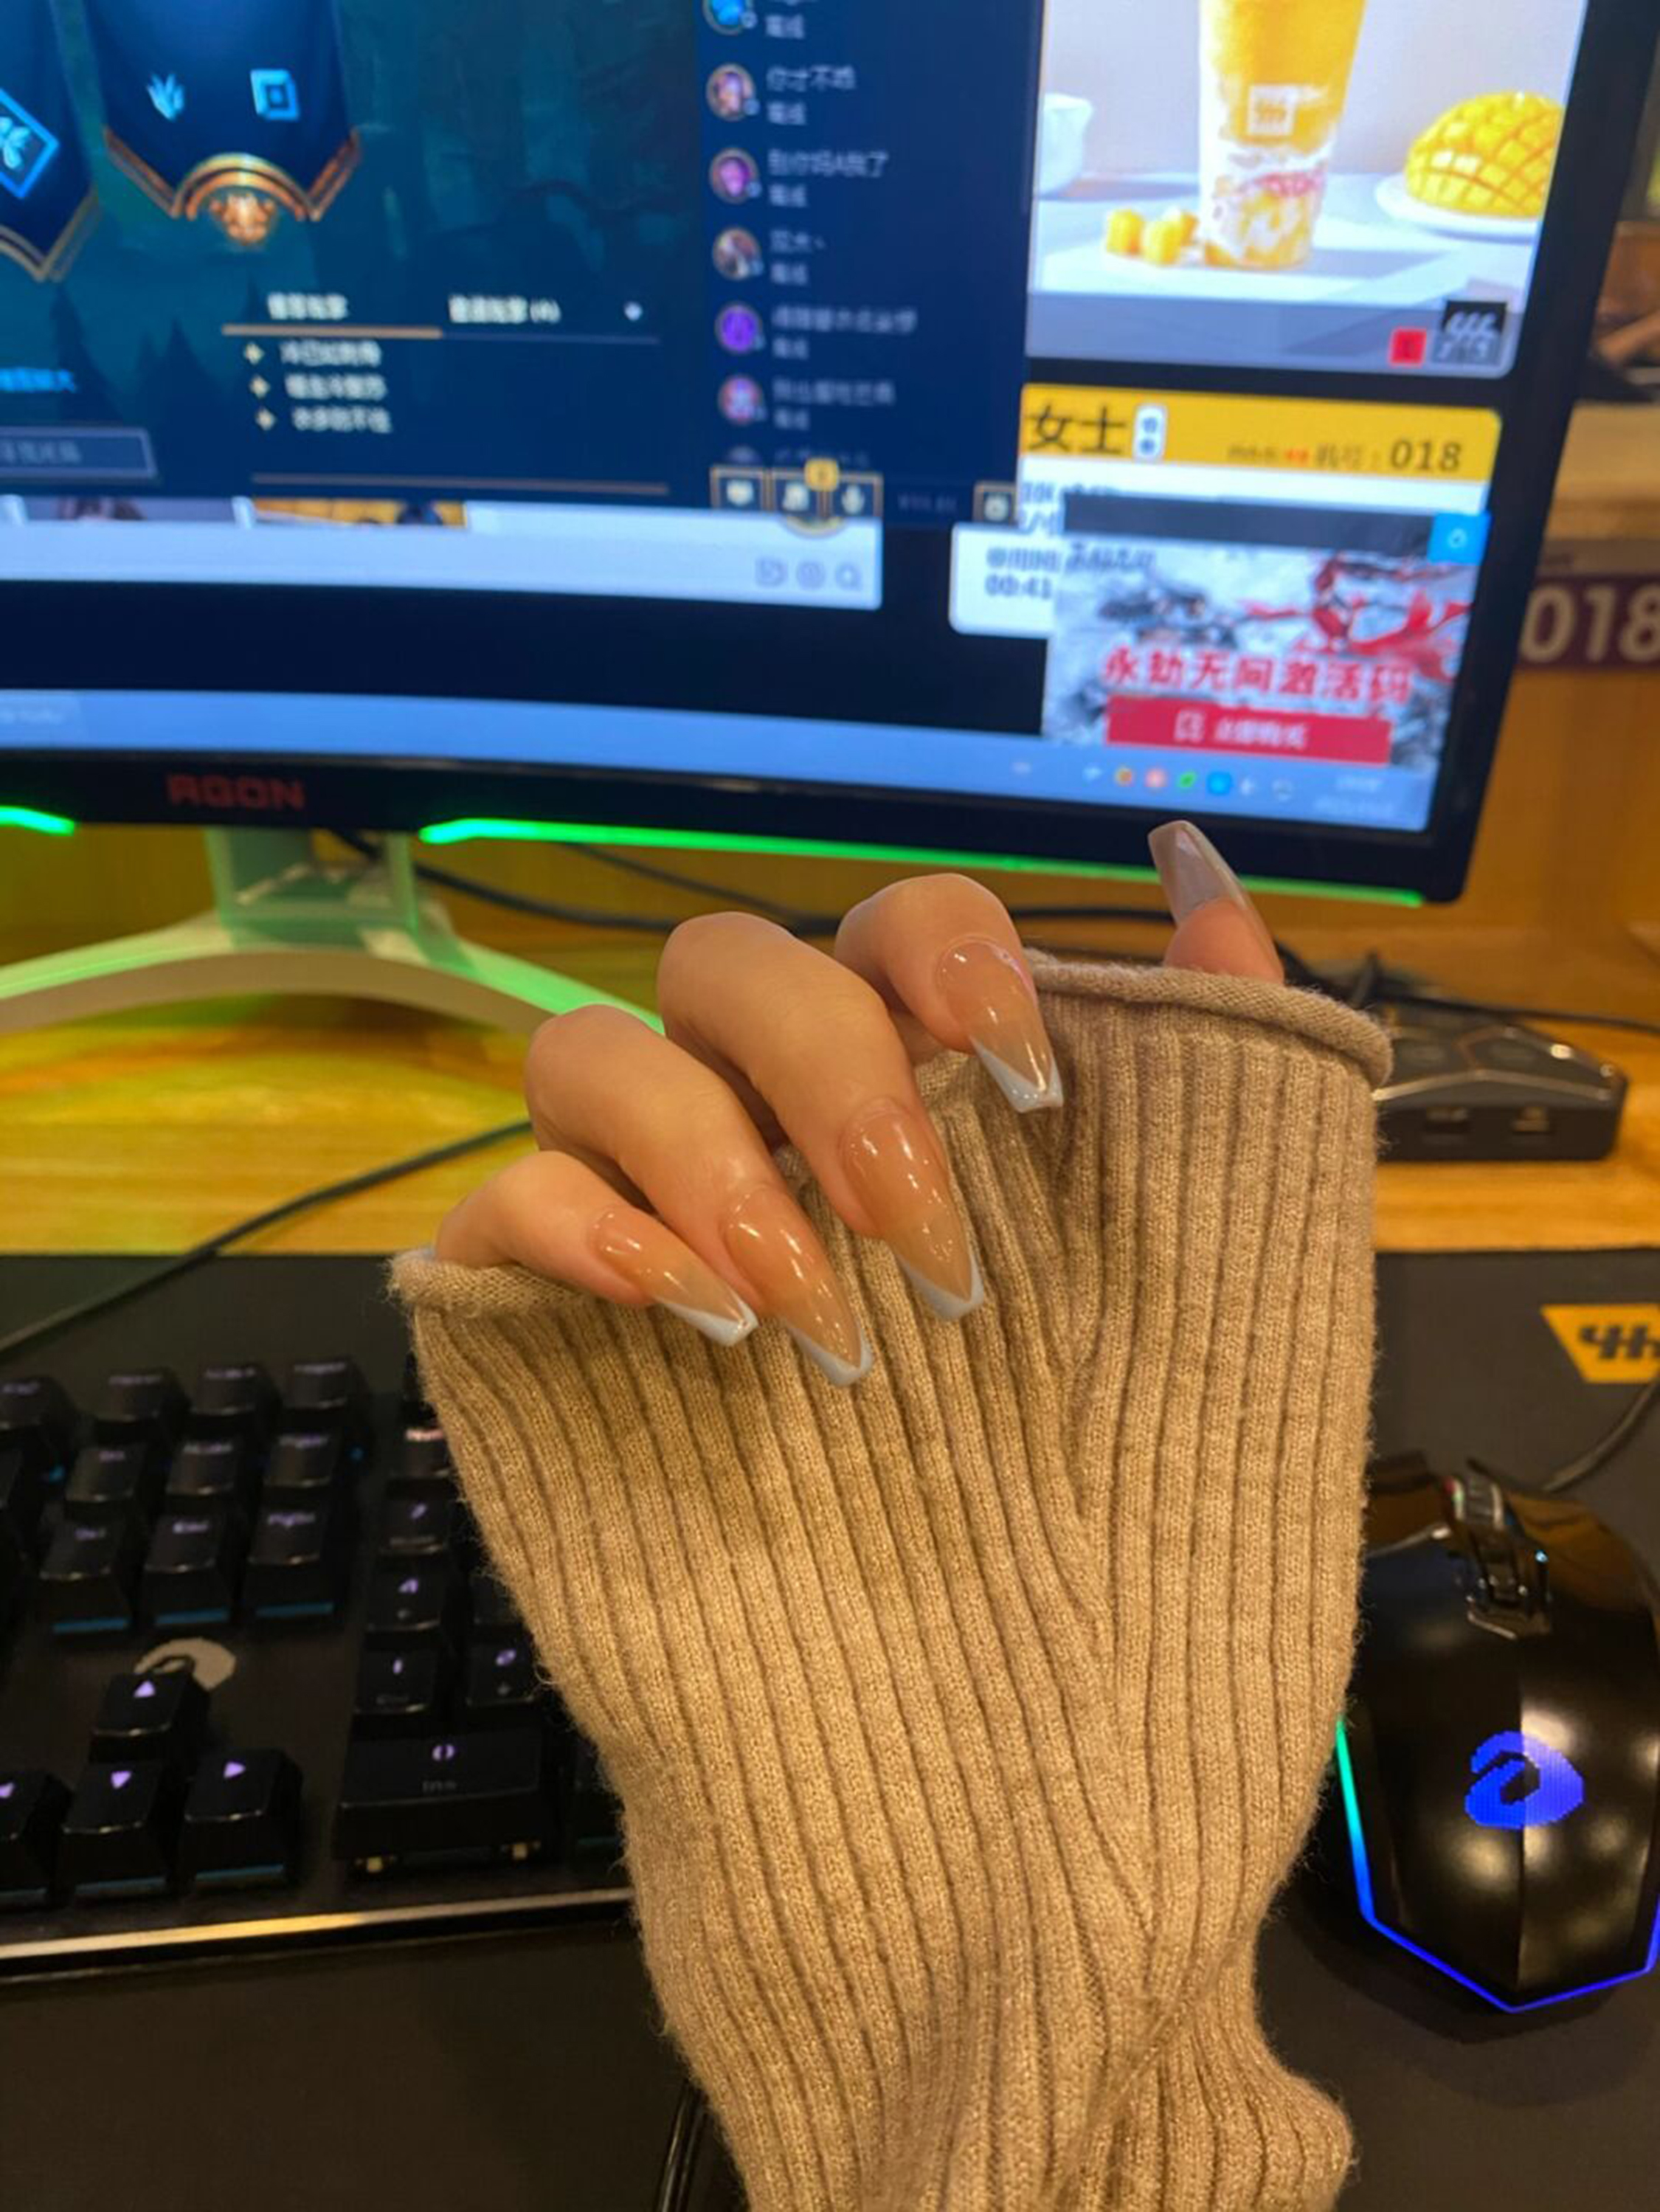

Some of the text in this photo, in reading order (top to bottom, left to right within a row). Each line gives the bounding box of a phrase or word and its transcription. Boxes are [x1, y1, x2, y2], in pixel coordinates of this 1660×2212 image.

[1025, 404, 1127, 454] 女士
[1390, 438, 1463, 472] 018
[1518, 584, 1660, 663] 018
